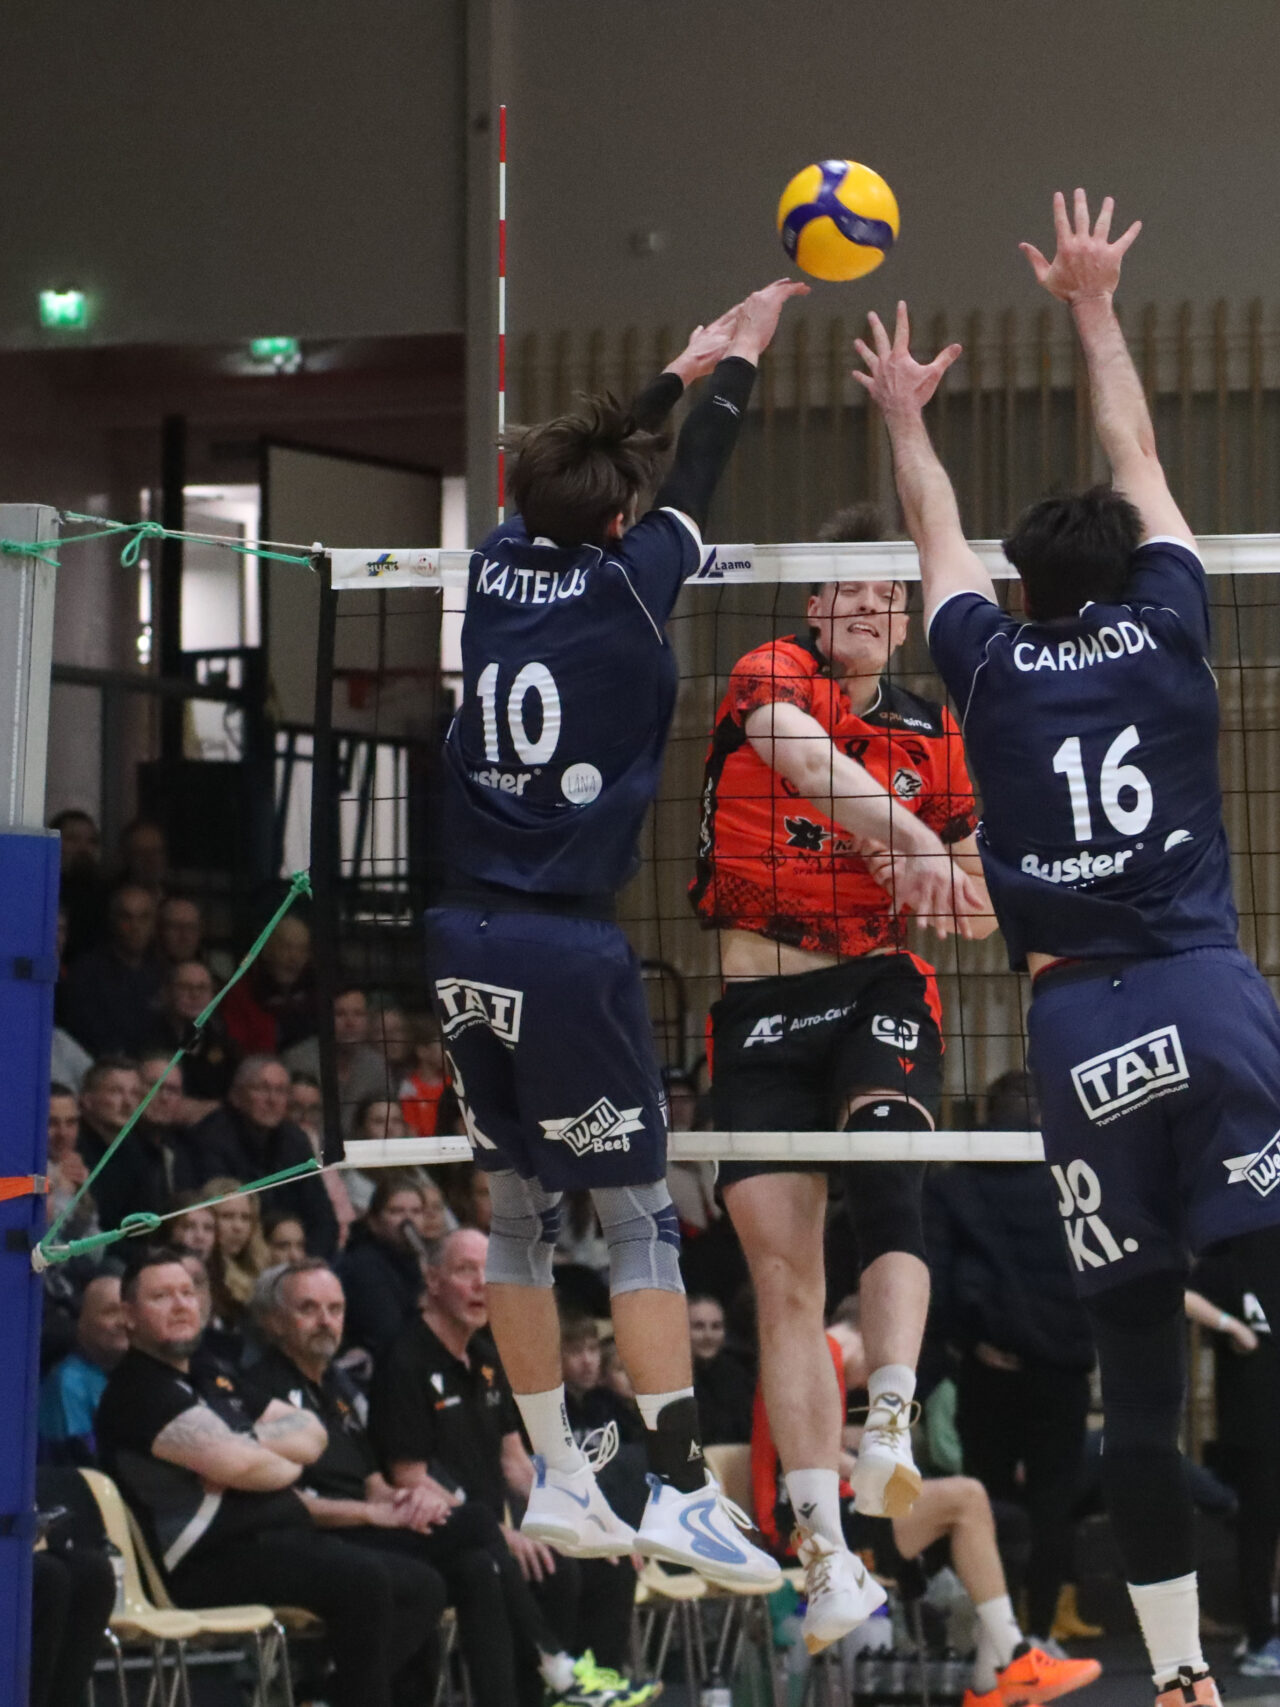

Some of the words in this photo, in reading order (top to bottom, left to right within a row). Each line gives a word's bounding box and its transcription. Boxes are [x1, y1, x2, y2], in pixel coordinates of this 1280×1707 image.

[715, 560, 752, 571] Laamo
[476, 662, 561, 766] 10
[1053, 724, 1153, 841] 16
[437, 985, 512, 1032] TAI
[1081, 1037, 1175, 1103] TAI
[566, 1103, 615, 1149] Well
[592, 1134, 631, 1153] Beef
[1050, 1159, 1102, 1217] JO
[1063, 1213, 1139, 1272] KI.
